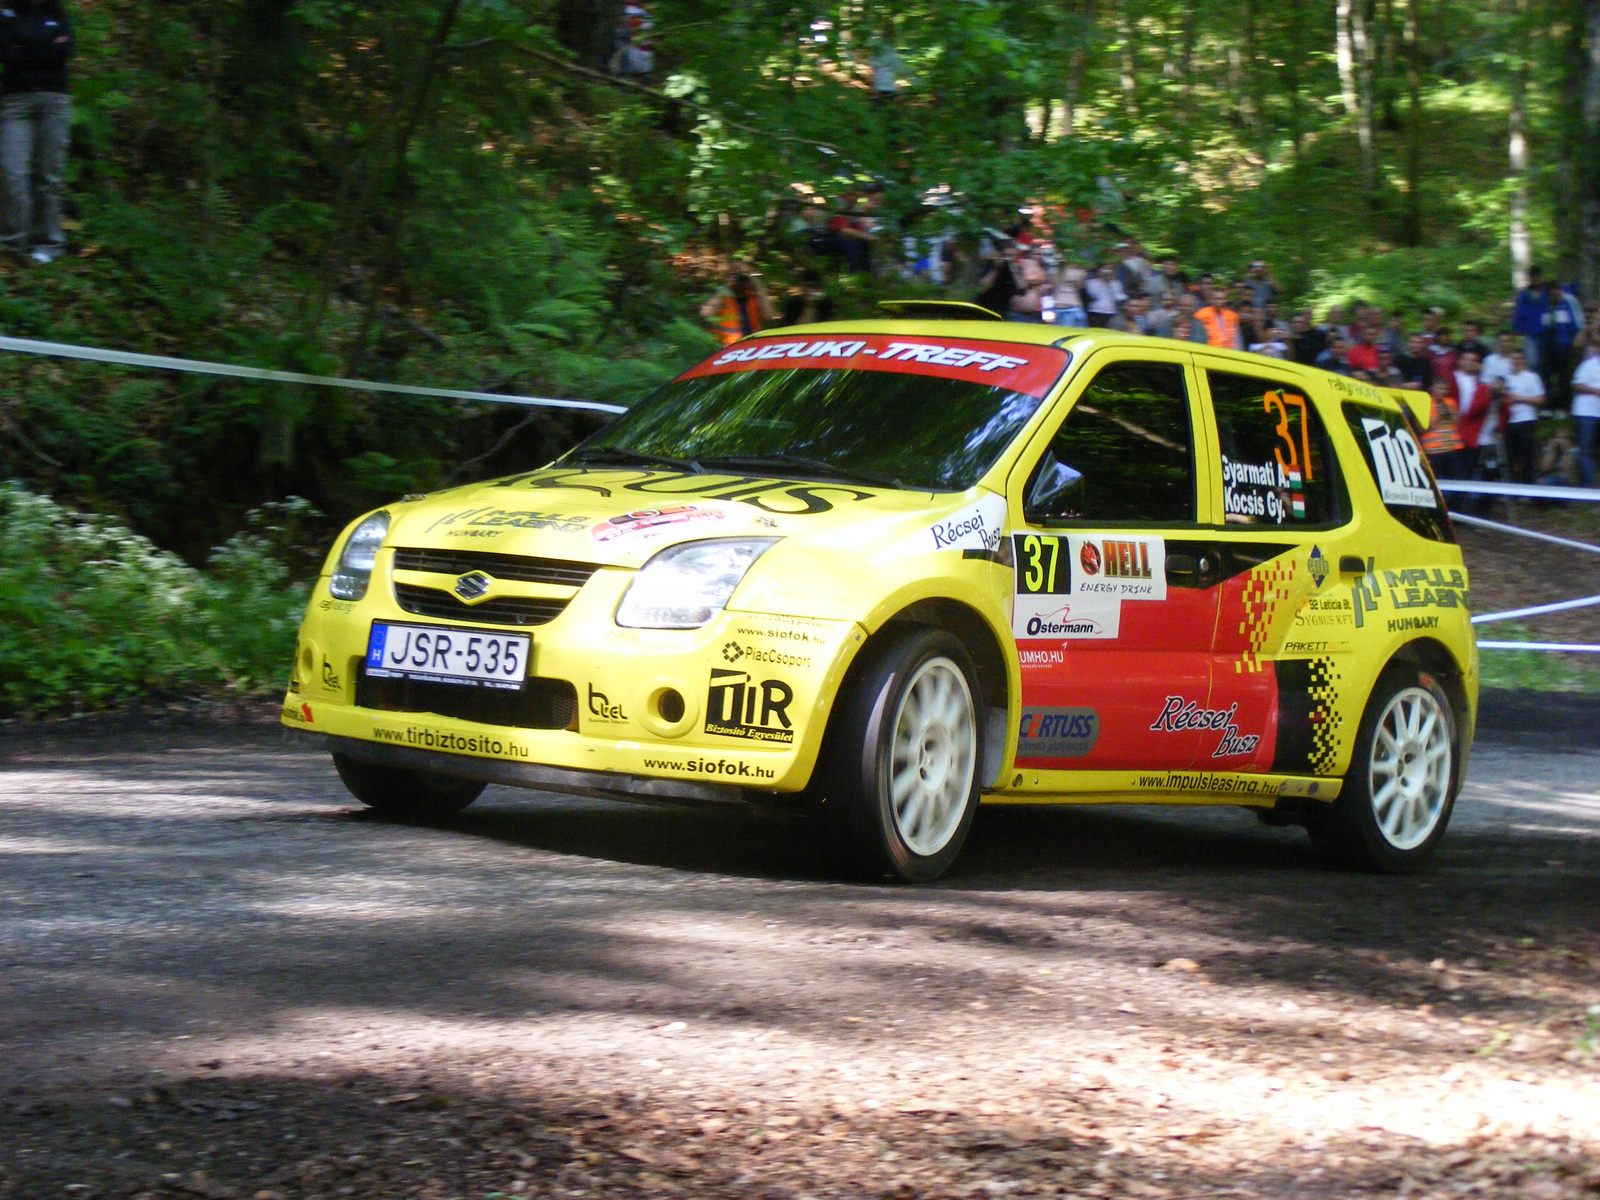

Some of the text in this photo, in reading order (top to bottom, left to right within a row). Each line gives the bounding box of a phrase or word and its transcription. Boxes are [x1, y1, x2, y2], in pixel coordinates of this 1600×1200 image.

[1264, 390, 1313, 480] 37
[1222, 454, 1290, 488] Gyarmati A.
[1224, 486, 1286, 524] Kocsis Gy.
[929, 509, 985, 550] Récsei
[978, 527, 1001, 551] Busz
[1024, 535, 1060, 593] 37
[1102, 541, 1152, 579] HELL
[1080, 582, 1152, 594] ENERGY DRINK
[1309, 599, 1318, 610] 92
[1027, 617, 1094, 636] Ostermann
[1295, 609, 1334, 626] SYGNUS
[1387, 616, 1439, 632] HUNGARY
[737, 627, 826, 645] www.siofok.hu
[1284, 641, 1329, 651] PAKETT
[371, 650, 381, 661] H
[391, 632, 520, 675] JSR-535
[745, 646, 811, 668] PiacCsoport
[1017, 650, 1064, 663] UMHO.HU
[1018, 713, 1095, 738] CERTUSS
[1150, 695, 1238, 732] Récsei
[373, 726, 529, 757] www.tirbiztosito.hu
[705, 723, 793, 742] Biztosító Egyesület
[1212, 724, 1260, 758] Busz
[644, 757, 775, 779] www.siofok.hu
[1139, 771, 1279, 795] www.impulsleasing.hu
